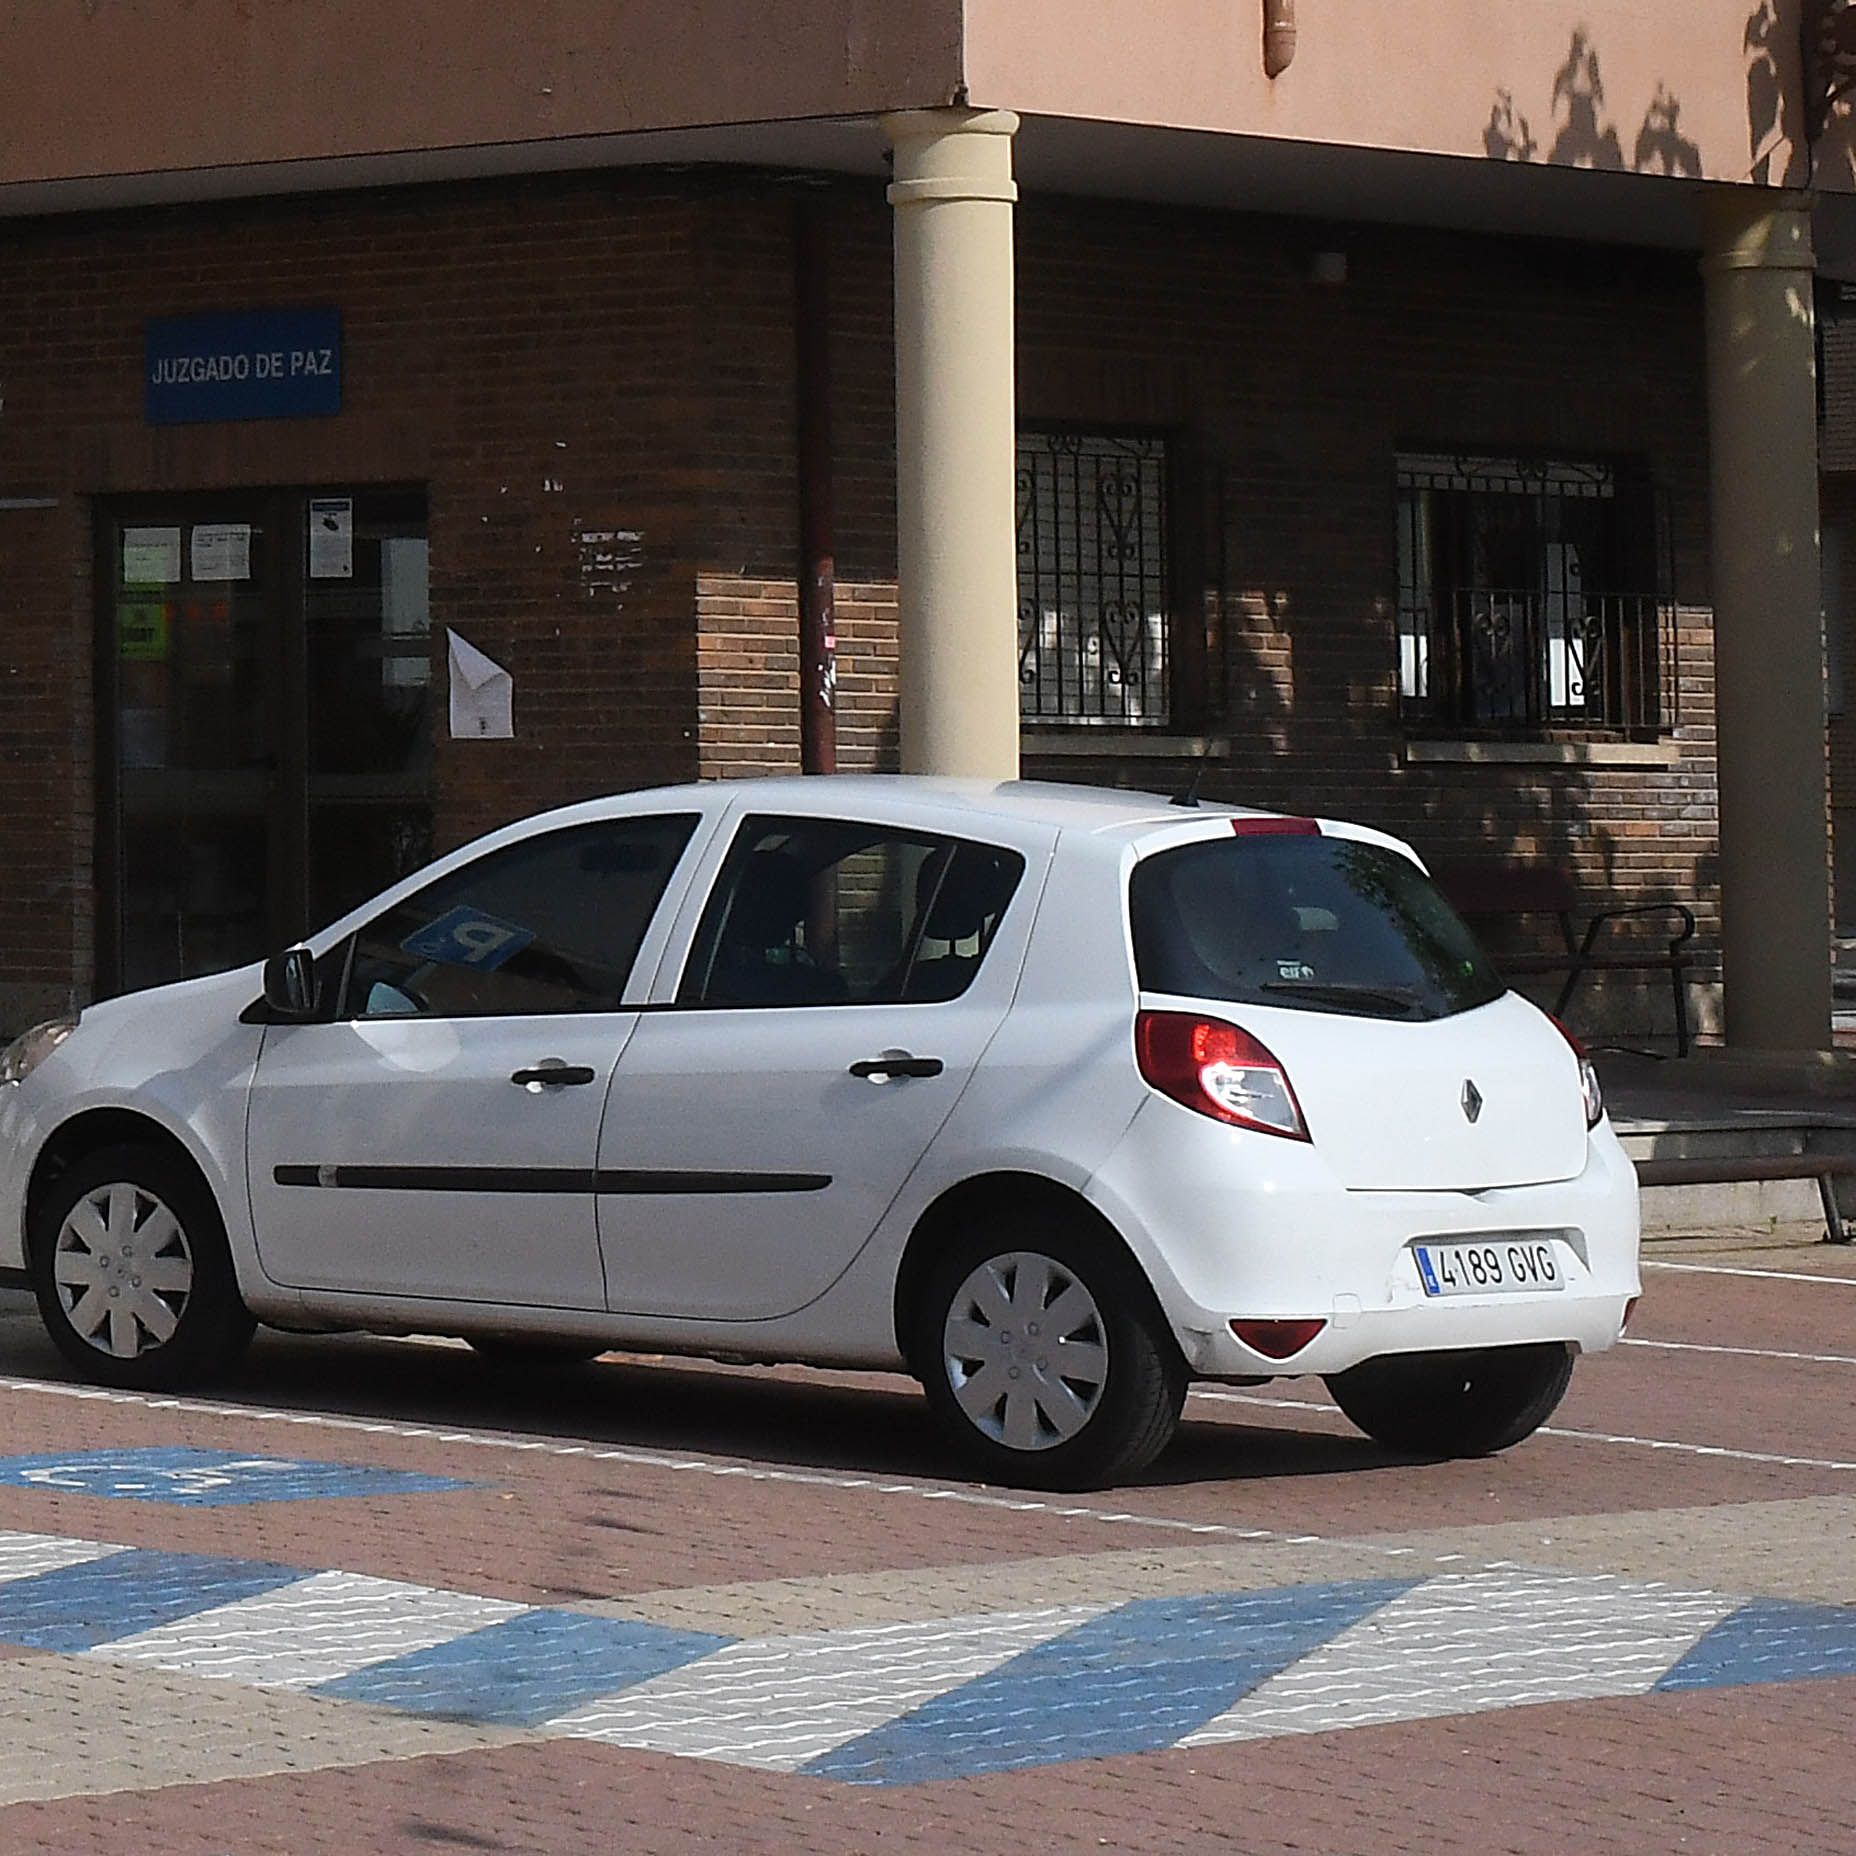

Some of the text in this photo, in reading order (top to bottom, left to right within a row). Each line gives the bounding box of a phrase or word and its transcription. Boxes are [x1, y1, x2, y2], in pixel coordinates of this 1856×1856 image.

[152, 348, 333, 384] JUZGADO DE PAZ
[1439, 1245, 1556, 1287] 4189 GVG
